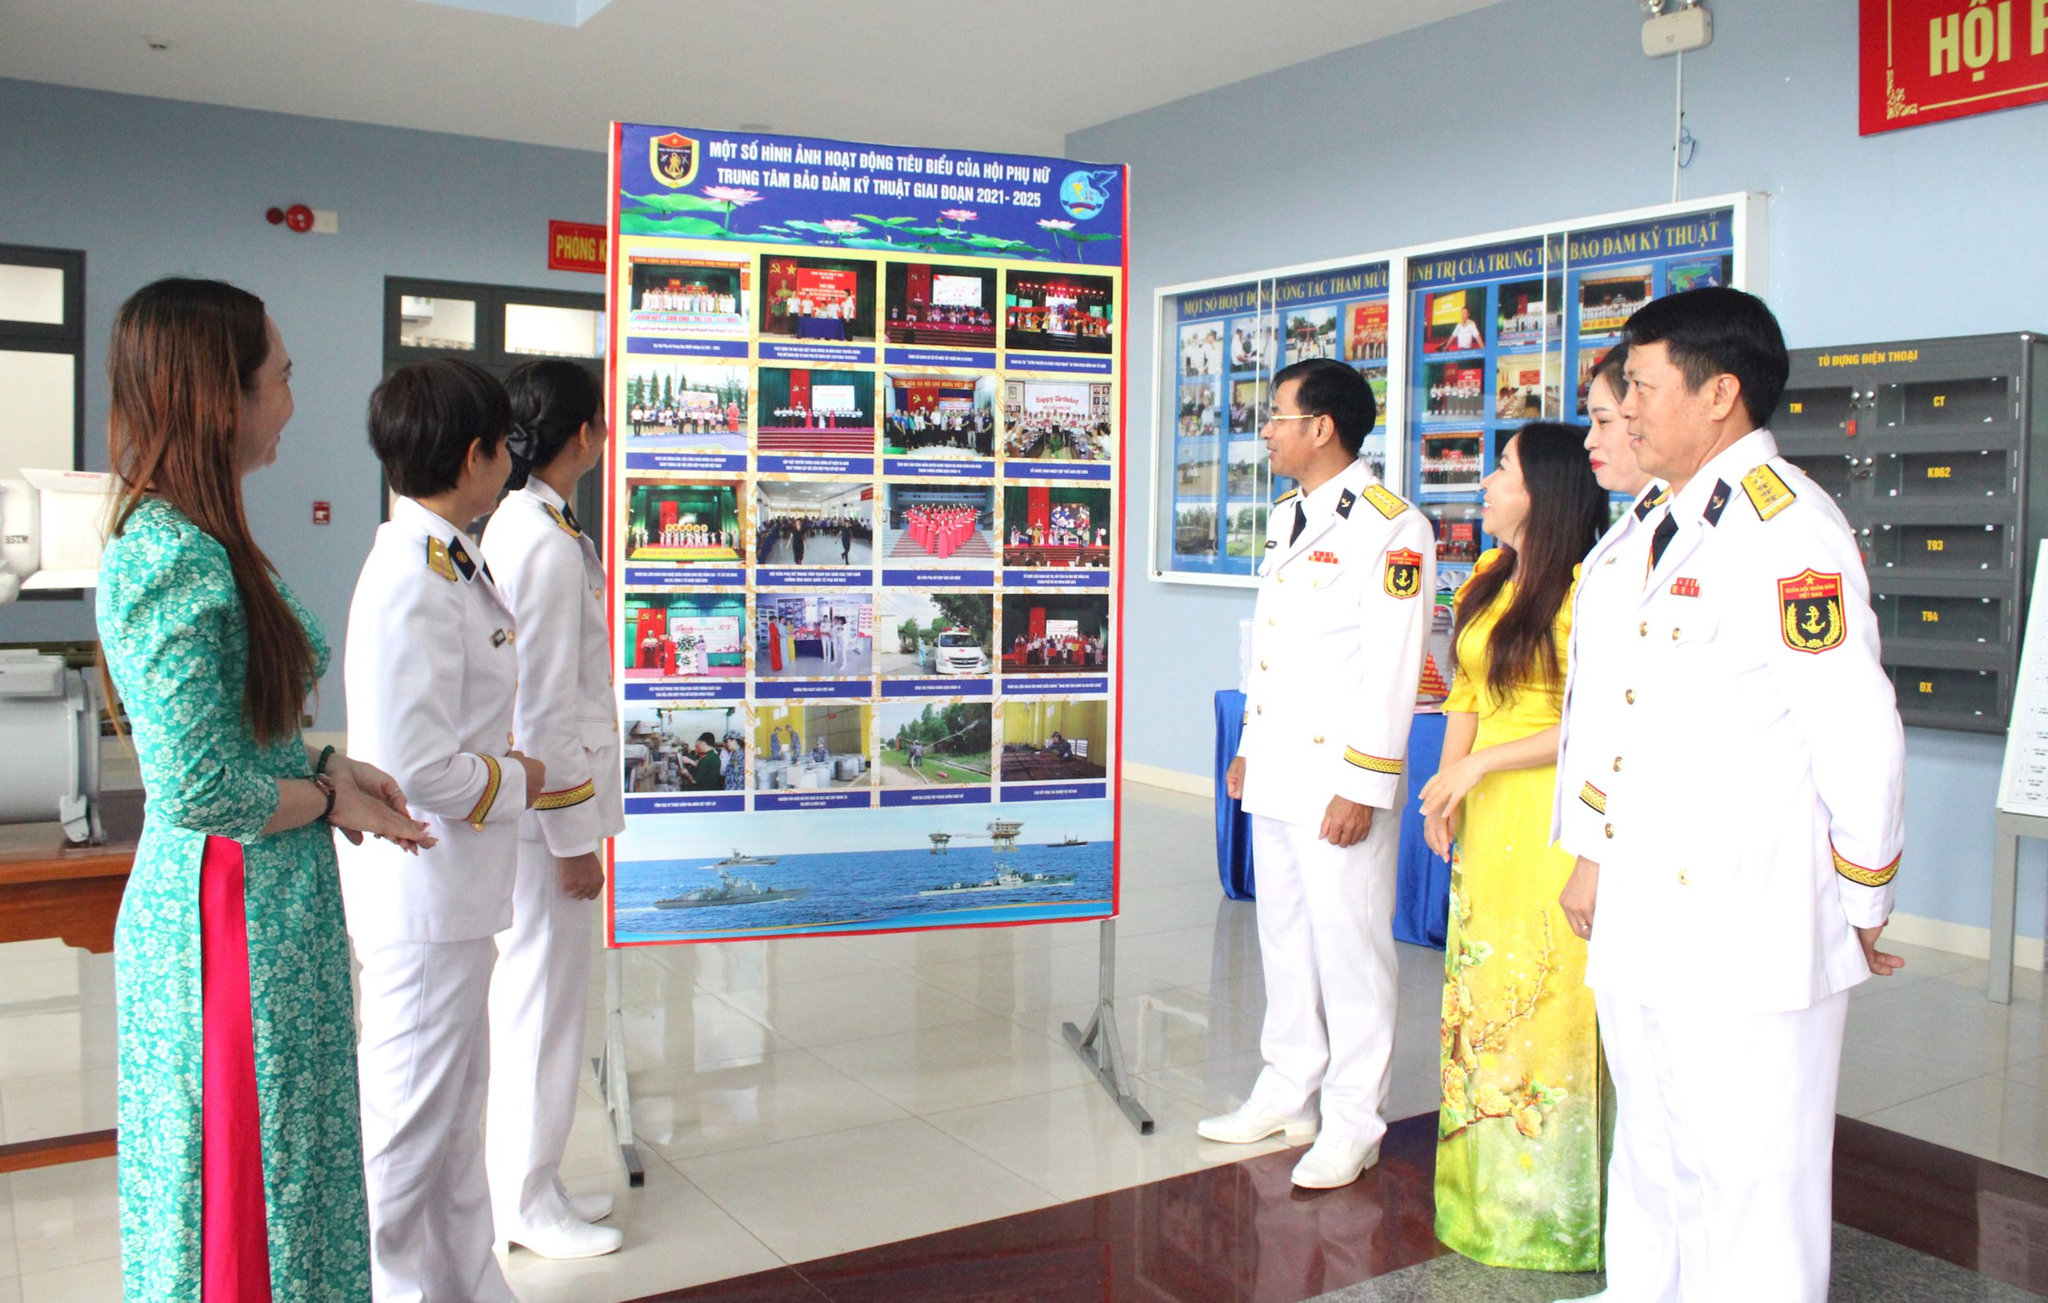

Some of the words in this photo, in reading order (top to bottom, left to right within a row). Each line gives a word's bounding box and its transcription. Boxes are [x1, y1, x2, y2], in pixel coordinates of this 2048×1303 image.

[1930, 0, 2011, 82] HỘI
[709, 140, 737, 161] MỘT
[741, 140, 758, 161] SỐ
[761, 143, 792, 163] HÌNH
[795, 143, 821, 165] ẢNH
[825, 151, 857, 171] HOẠT
[860, 151, 893, 172] ĐỘNG
[897, 154, 923, 173] TIÊU
[926, 154, 953, 175] BIỂU
[956, 157, 980, 178] CỦA
[984, 162, 1003, 182] HỘI
[1006, 165, 1030, 185] PHỤ
[1033, 166, 1051, 184] NỮ
[717, 168, 759, 186] TRUNG
[763, 168, 790, 188] TÂM
[793, 169, 819, 190] BẢO
[822, 171, 850, 192] ĐẢM
[854, 176, 870, 193] KỸ
[873, 178, 911, 199] THUẬT
[914, 182, 937, 198] GIAI
[941, 185, 974, 204] ĐOẠN
[1013, 191, 1041, 207] 2025
[556, 230, 596, 262] PHÒNG
[1436, 258, 1456, 281] TRỊ
[1459, 252, 1485, 276] CỦA
[1488, 249, 1533, 271] TRUNG
[1570, 235, 1600, 261] BẢO
[1603, 230, 1636, 256] ĐẢM
[1640, 226, 1662, 250] KỸ
[1665, 219, 1720, 248] THUẬT
[1205, 291, 1217, 311] SỐ
[1218, 292, 1246, 313] HOẠT
[1276, 279, 1305, 302] CÔNG
[1307, 277, 1328, 296] TÁC
[1330, 275, 1361, 294] THAM
[1818, 353, 1830, 367] TỦ
[1862, 350, 1886, 366] ĐIỆN
[1888, 349, 1918, 363] THOẠI
[1789, 403, 1803, 413] TM
[1933, 396, 1945, 407] CT
